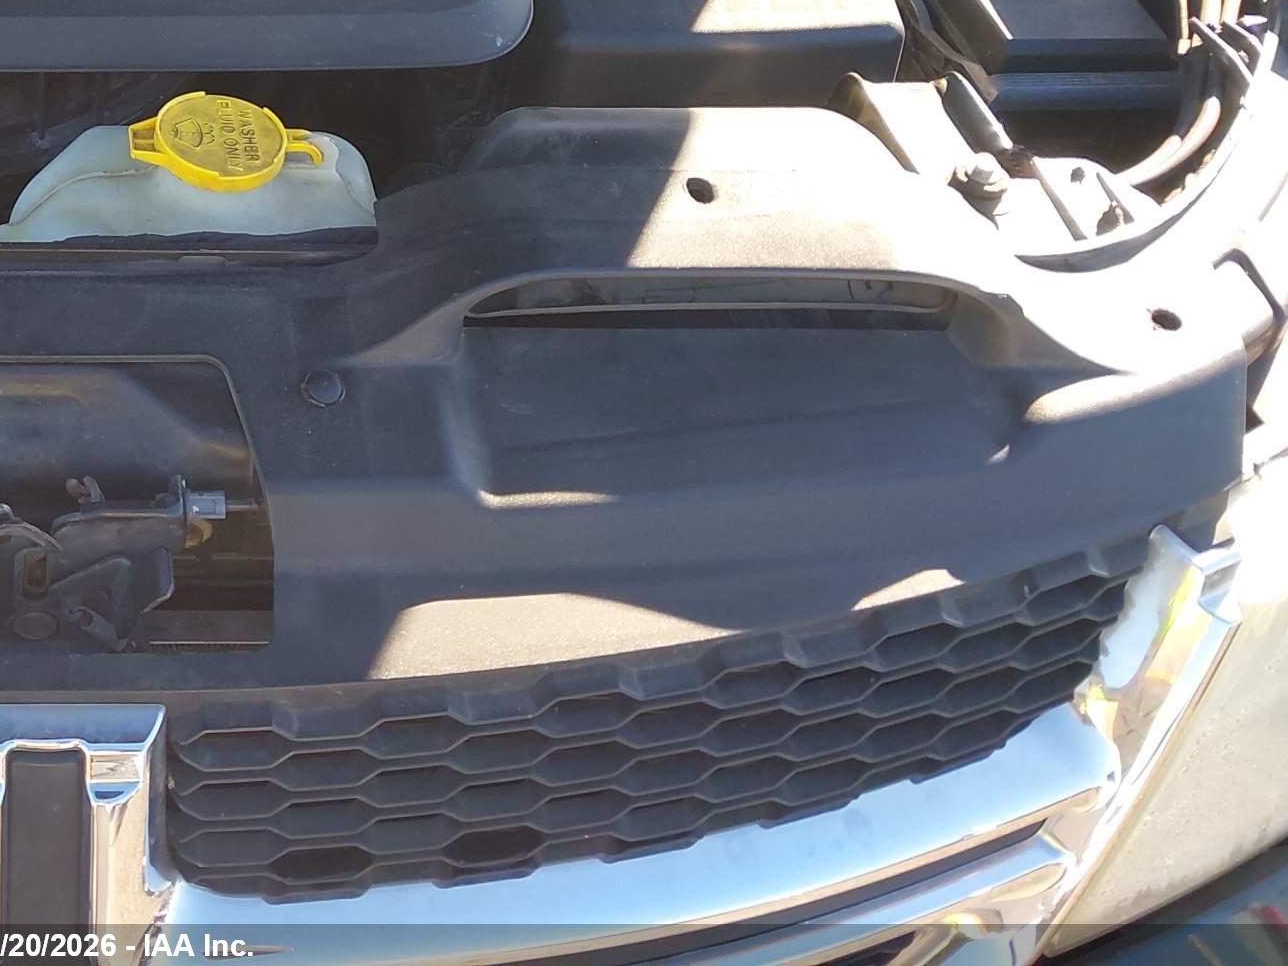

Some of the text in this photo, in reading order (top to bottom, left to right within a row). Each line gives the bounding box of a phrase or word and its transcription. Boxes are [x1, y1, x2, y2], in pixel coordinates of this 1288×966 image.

[216, 98, 244, 172] FLUID ONLY
[238, 109, 261, 163] WASHER
